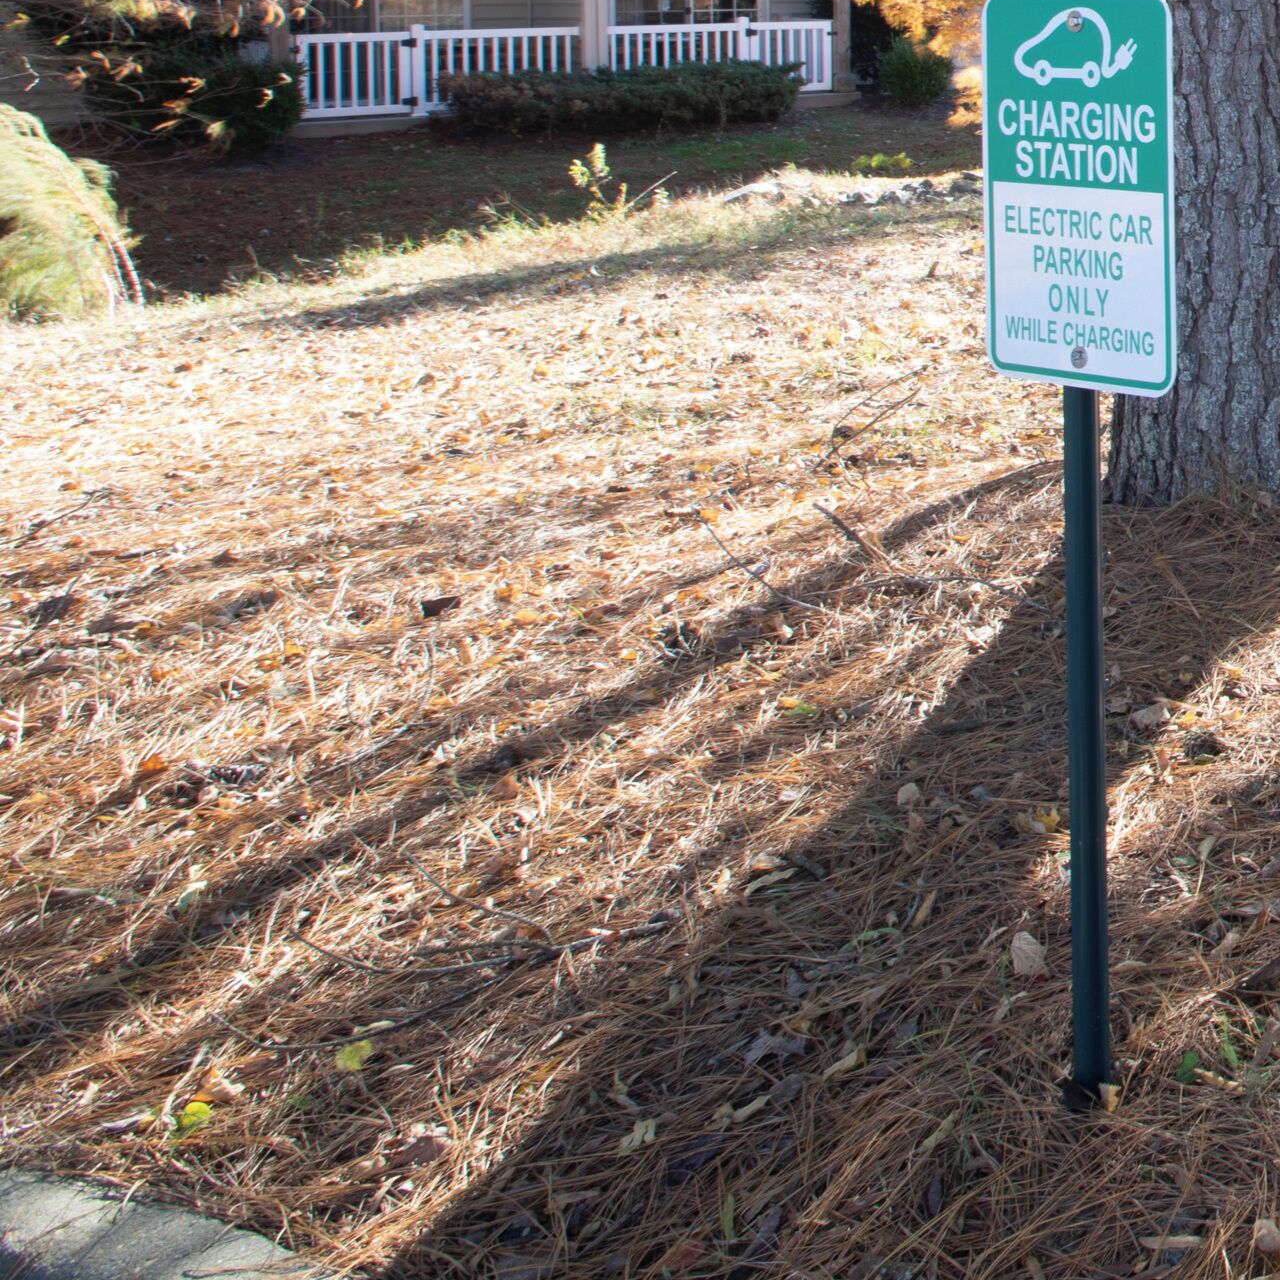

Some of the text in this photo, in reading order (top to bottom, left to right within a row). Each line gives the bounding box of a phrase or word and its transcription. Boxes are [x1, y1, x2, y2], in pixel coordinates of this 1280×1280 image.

[998, 98, 1156, 144] CHARGING
[1015, 140, 1138, 185] STATION
[1005, 205, 1153, 246] ELECTRIC CAR
[1033, 245, 1123, 281] PARKING
[1048, 282, 1109, 318] ONLY
[1005, 314, 1154, 357] WHILE CHARGING
